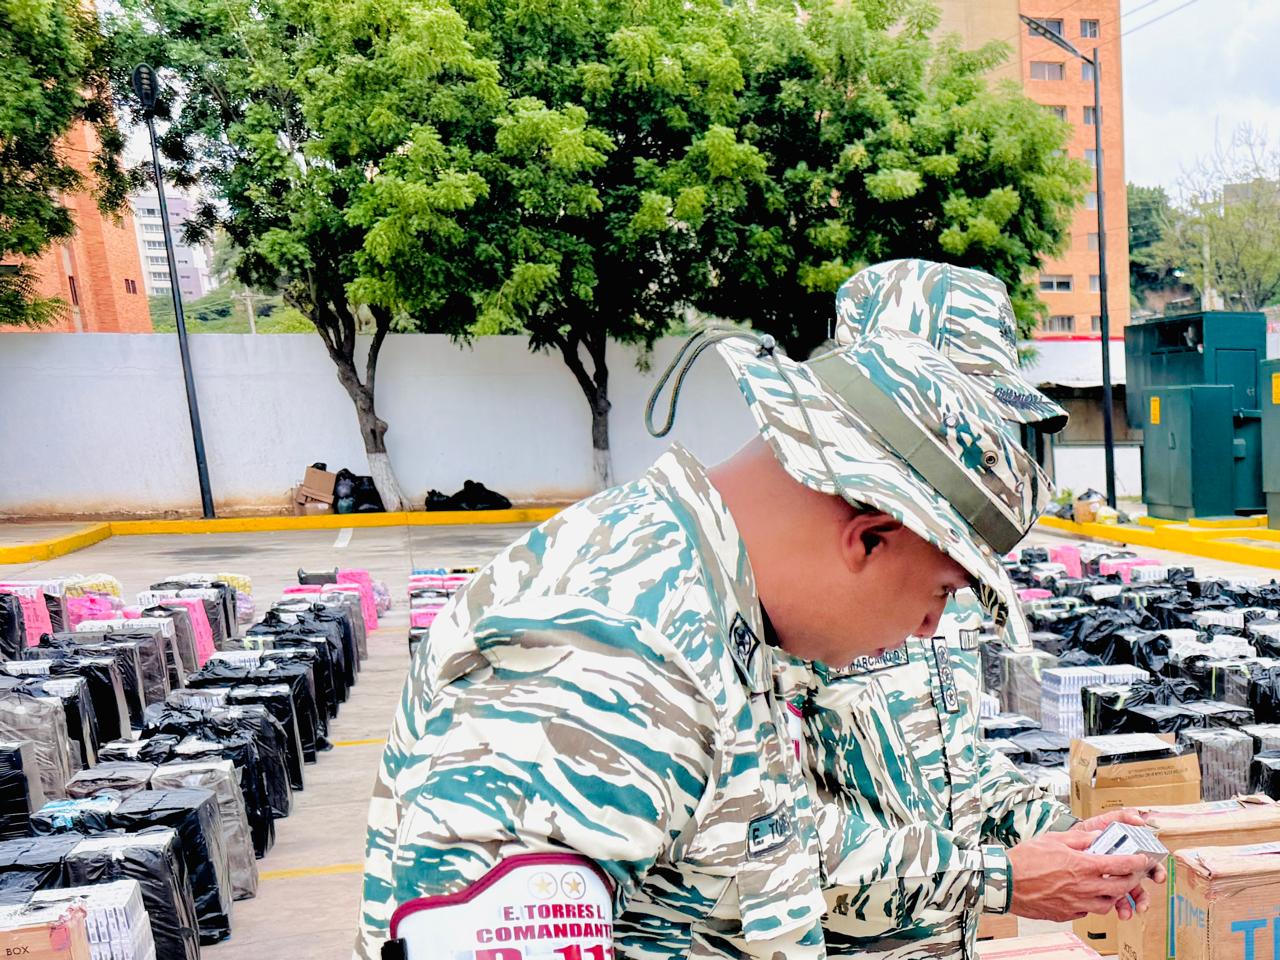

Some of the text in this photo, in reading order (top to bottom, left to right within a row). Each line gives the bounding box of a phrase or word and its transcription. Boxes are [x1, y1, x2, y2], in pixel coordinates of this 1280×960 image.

[524, 904, 594, 921] TORRES
[1177, 894, 1206, 929] TIME
[6, 945, 30, 956] BOX
